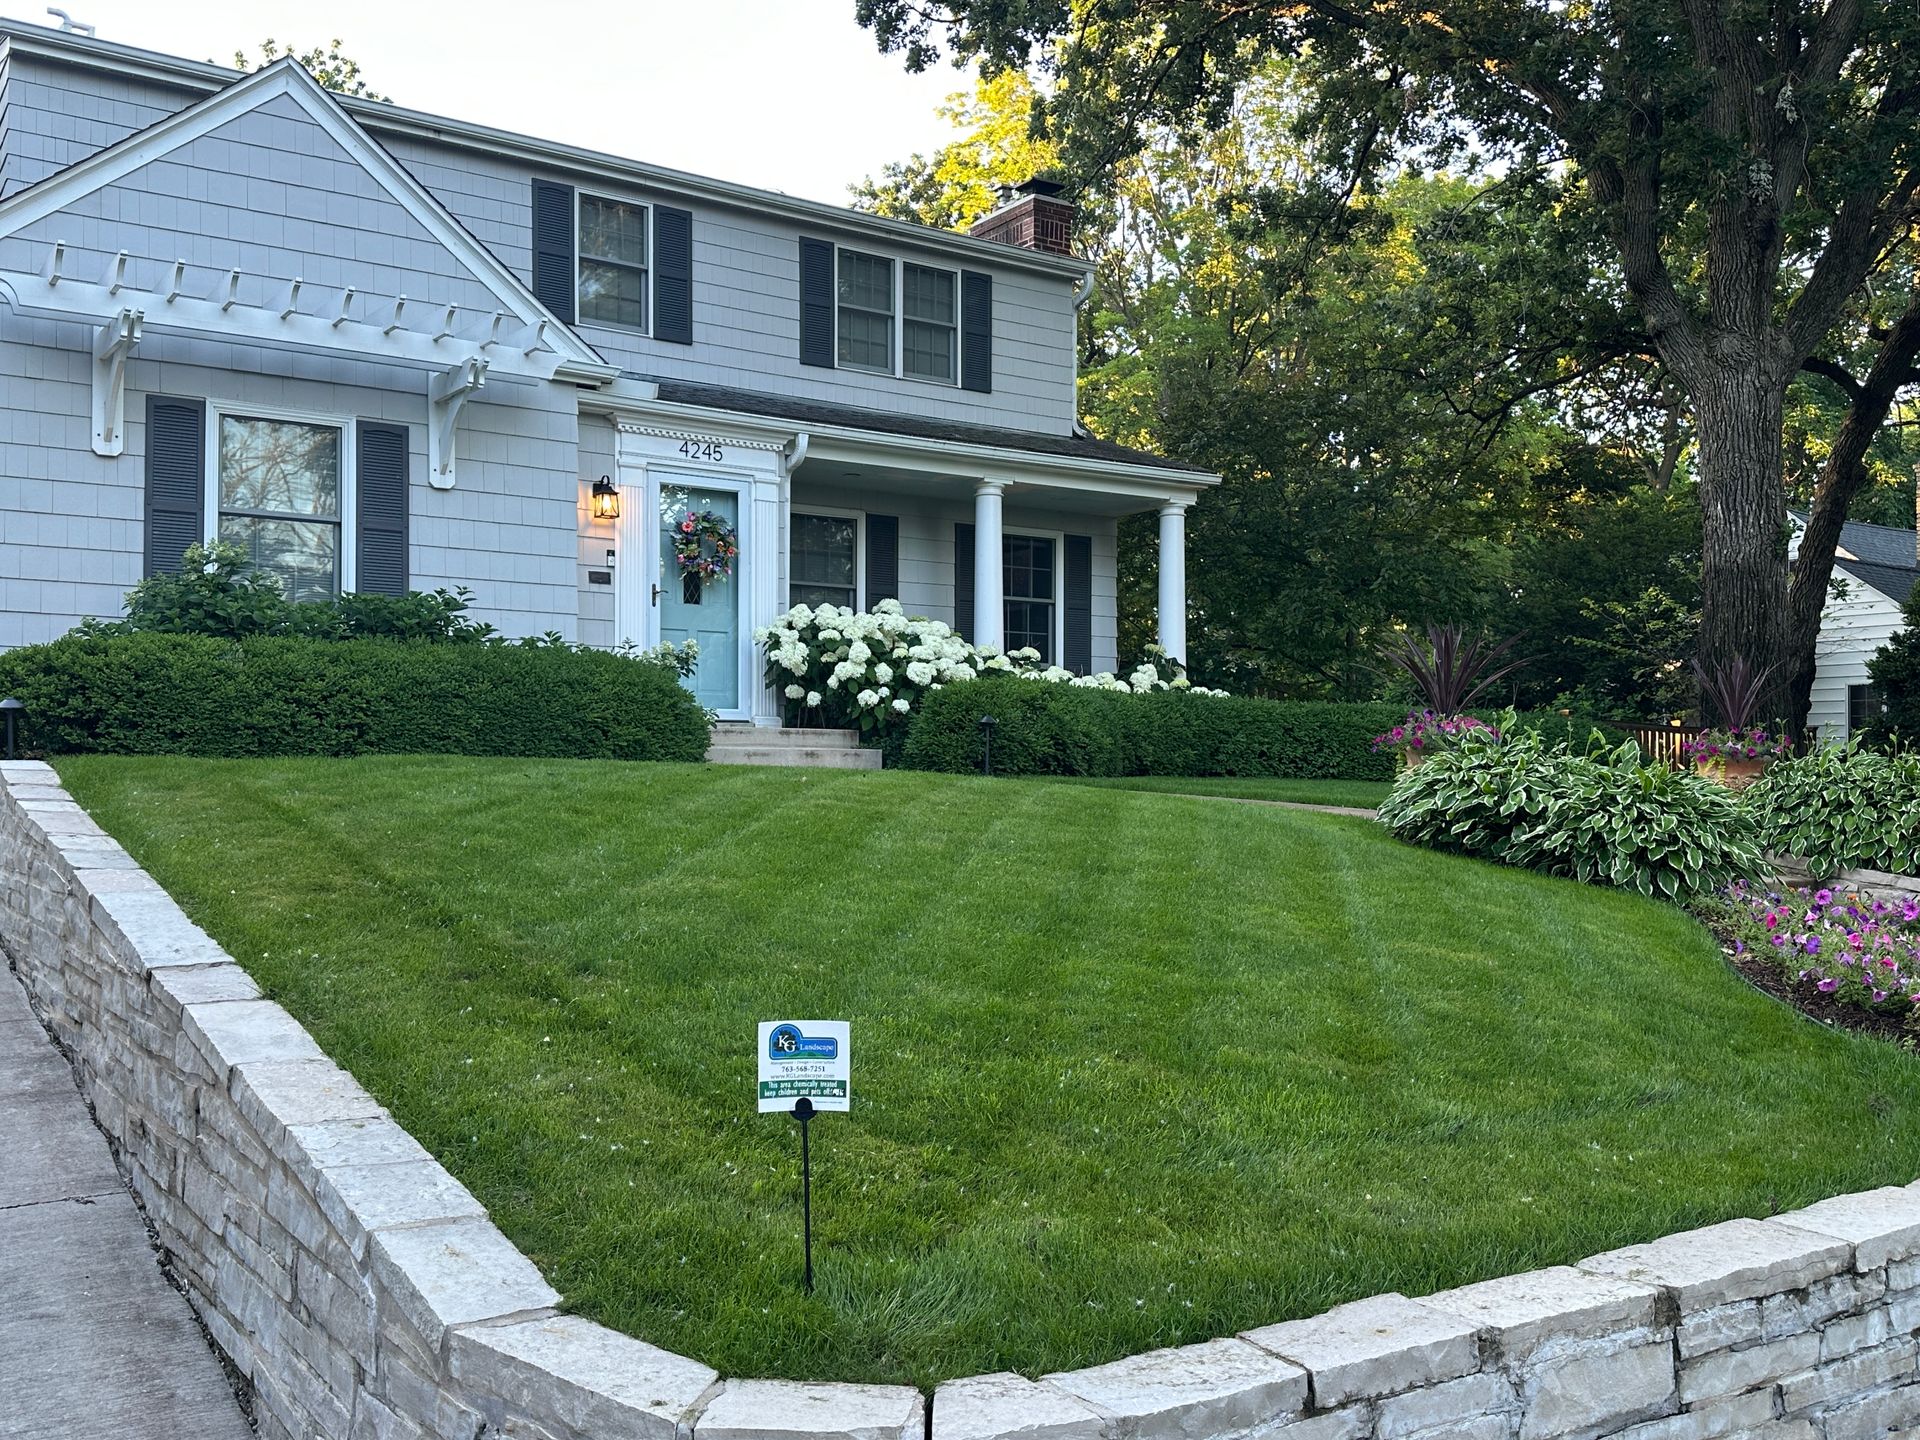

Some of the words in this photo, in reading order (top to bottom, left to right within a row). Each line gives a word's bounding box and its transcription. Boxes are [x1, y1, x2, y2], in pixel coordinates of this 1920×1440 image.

[679, 440, 723, 462] 4245
[778, 1035, 796, 1053] KG
[800, 1043, 834, 1053] Landscape
[781, 1065, 825, 1073] 763-568-7251
[793, 1080, 818, 1089] chemically
[764, 1089, 776, 1097] keep
[778, 1088, 798, 1096] children
